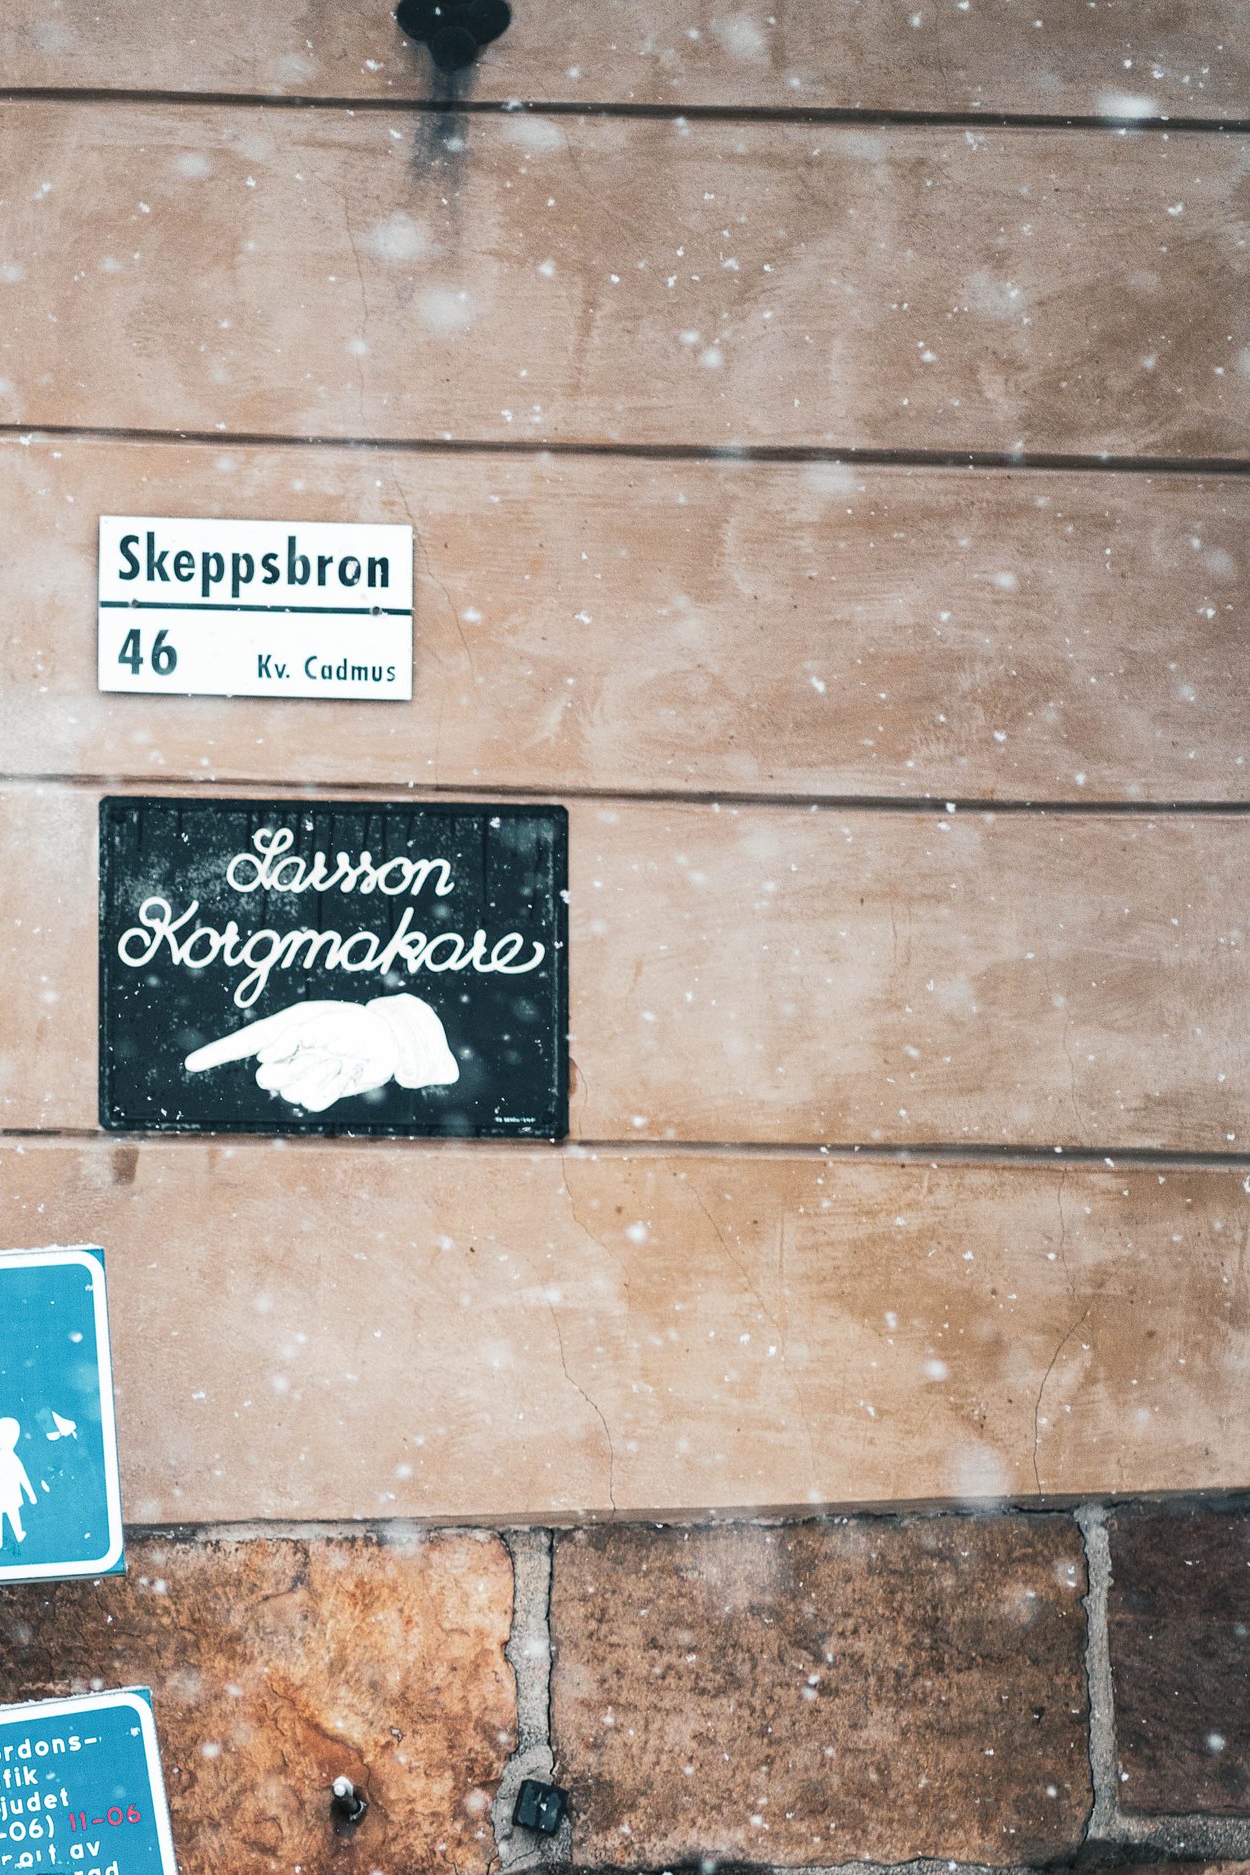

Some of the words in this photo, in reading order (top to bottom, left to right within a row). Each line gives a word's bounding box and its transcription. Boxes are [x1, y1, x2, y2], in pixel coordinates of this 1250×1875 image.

[118, 532, 389, 598] Skeppsbron
[118, 629, 178, 676] 46
[257, 654, 290, 679] Kv.
[304, 656, 396, 682] Cadmus
[226, 827, 455, 896] Larsson
[117, 896, 546, 1009] Korgmakare
[68, 1804, 141, 1832] 11-06
[69, 1840, 101, 1860] av
